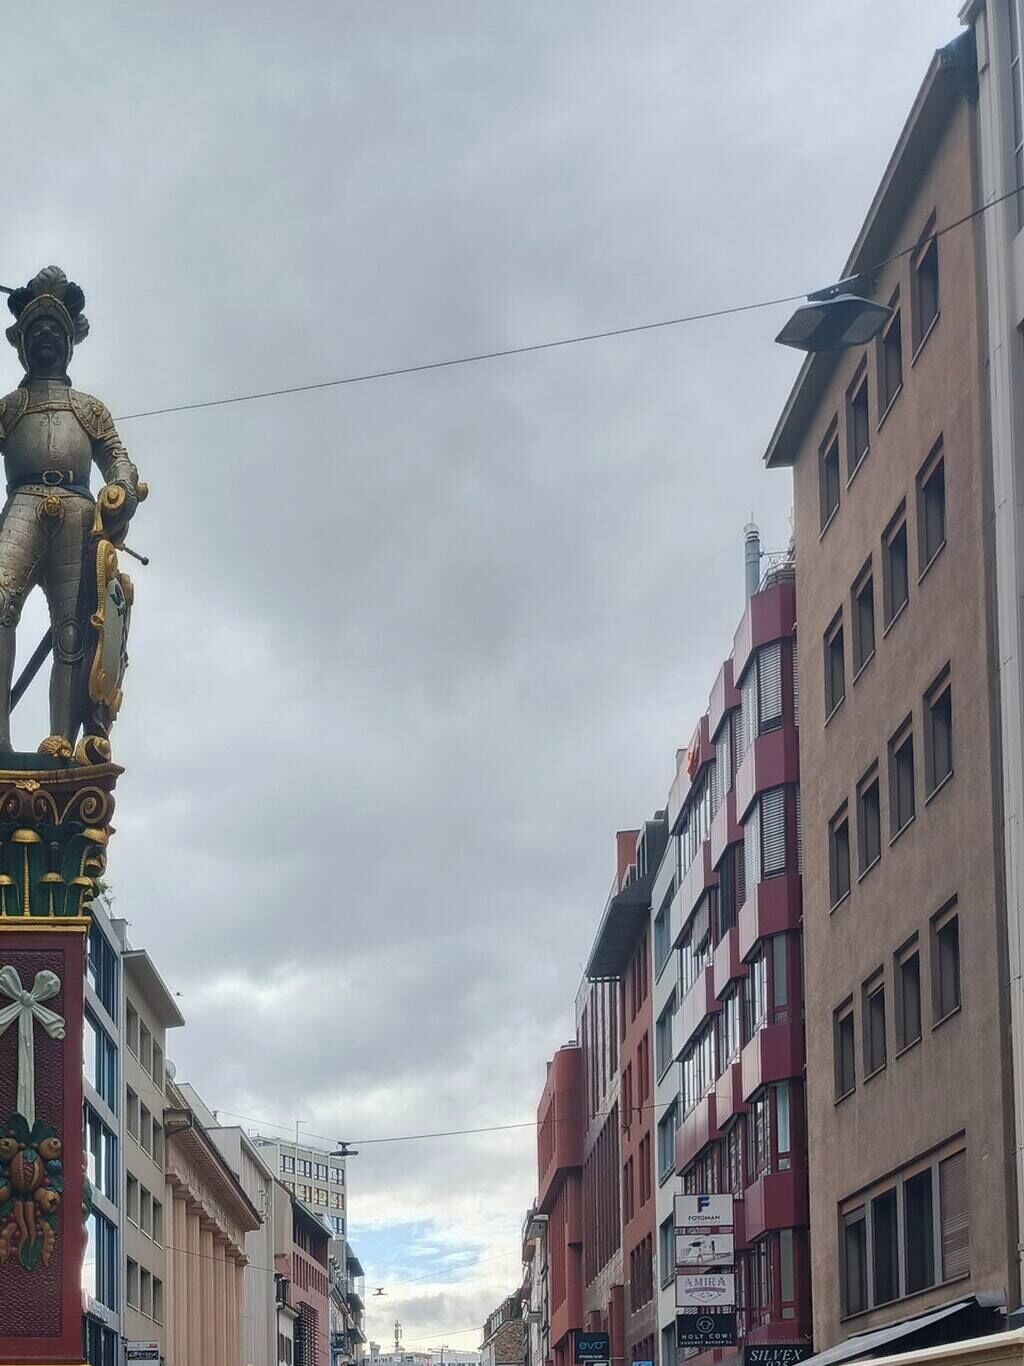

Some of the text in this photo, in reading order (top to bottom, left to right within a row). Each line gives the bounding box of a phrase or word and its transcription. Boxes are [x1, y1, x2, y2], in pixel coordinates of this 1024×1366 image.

[684, 1277, 726, 1287] AMIRA
[578, 1340, 607, 1351] evo
[749, 1349, 803, 1361] SILVEX
